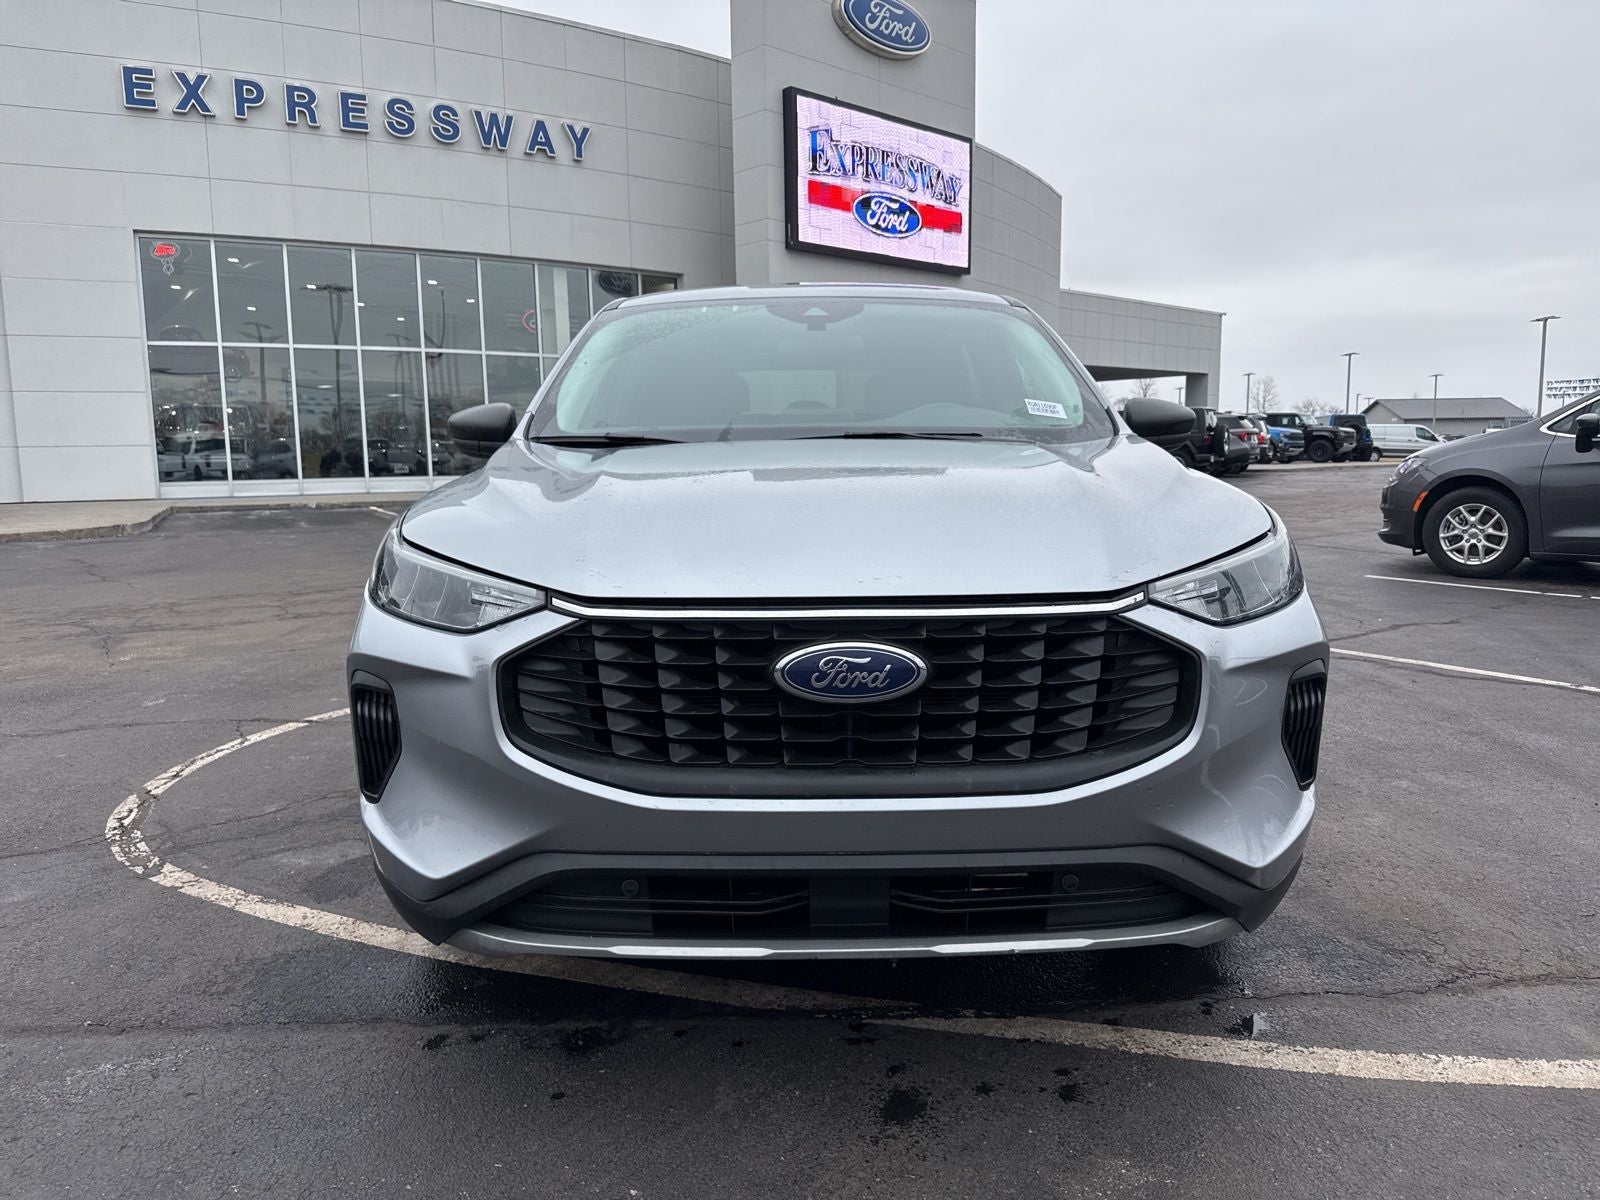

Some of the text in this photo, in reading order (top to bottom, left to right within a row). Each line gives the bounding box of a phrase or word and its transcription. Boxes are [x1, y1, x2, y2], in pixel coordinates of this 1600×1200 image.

[865, 0, 916, 43] Ford
[120, 65, 592, 161] EXPRESSWAY
[808, 127, 963, 206] EXPRESSWAY
[866, 197, 910, 232] Ford
[810, 655, 892, 689] Ford
